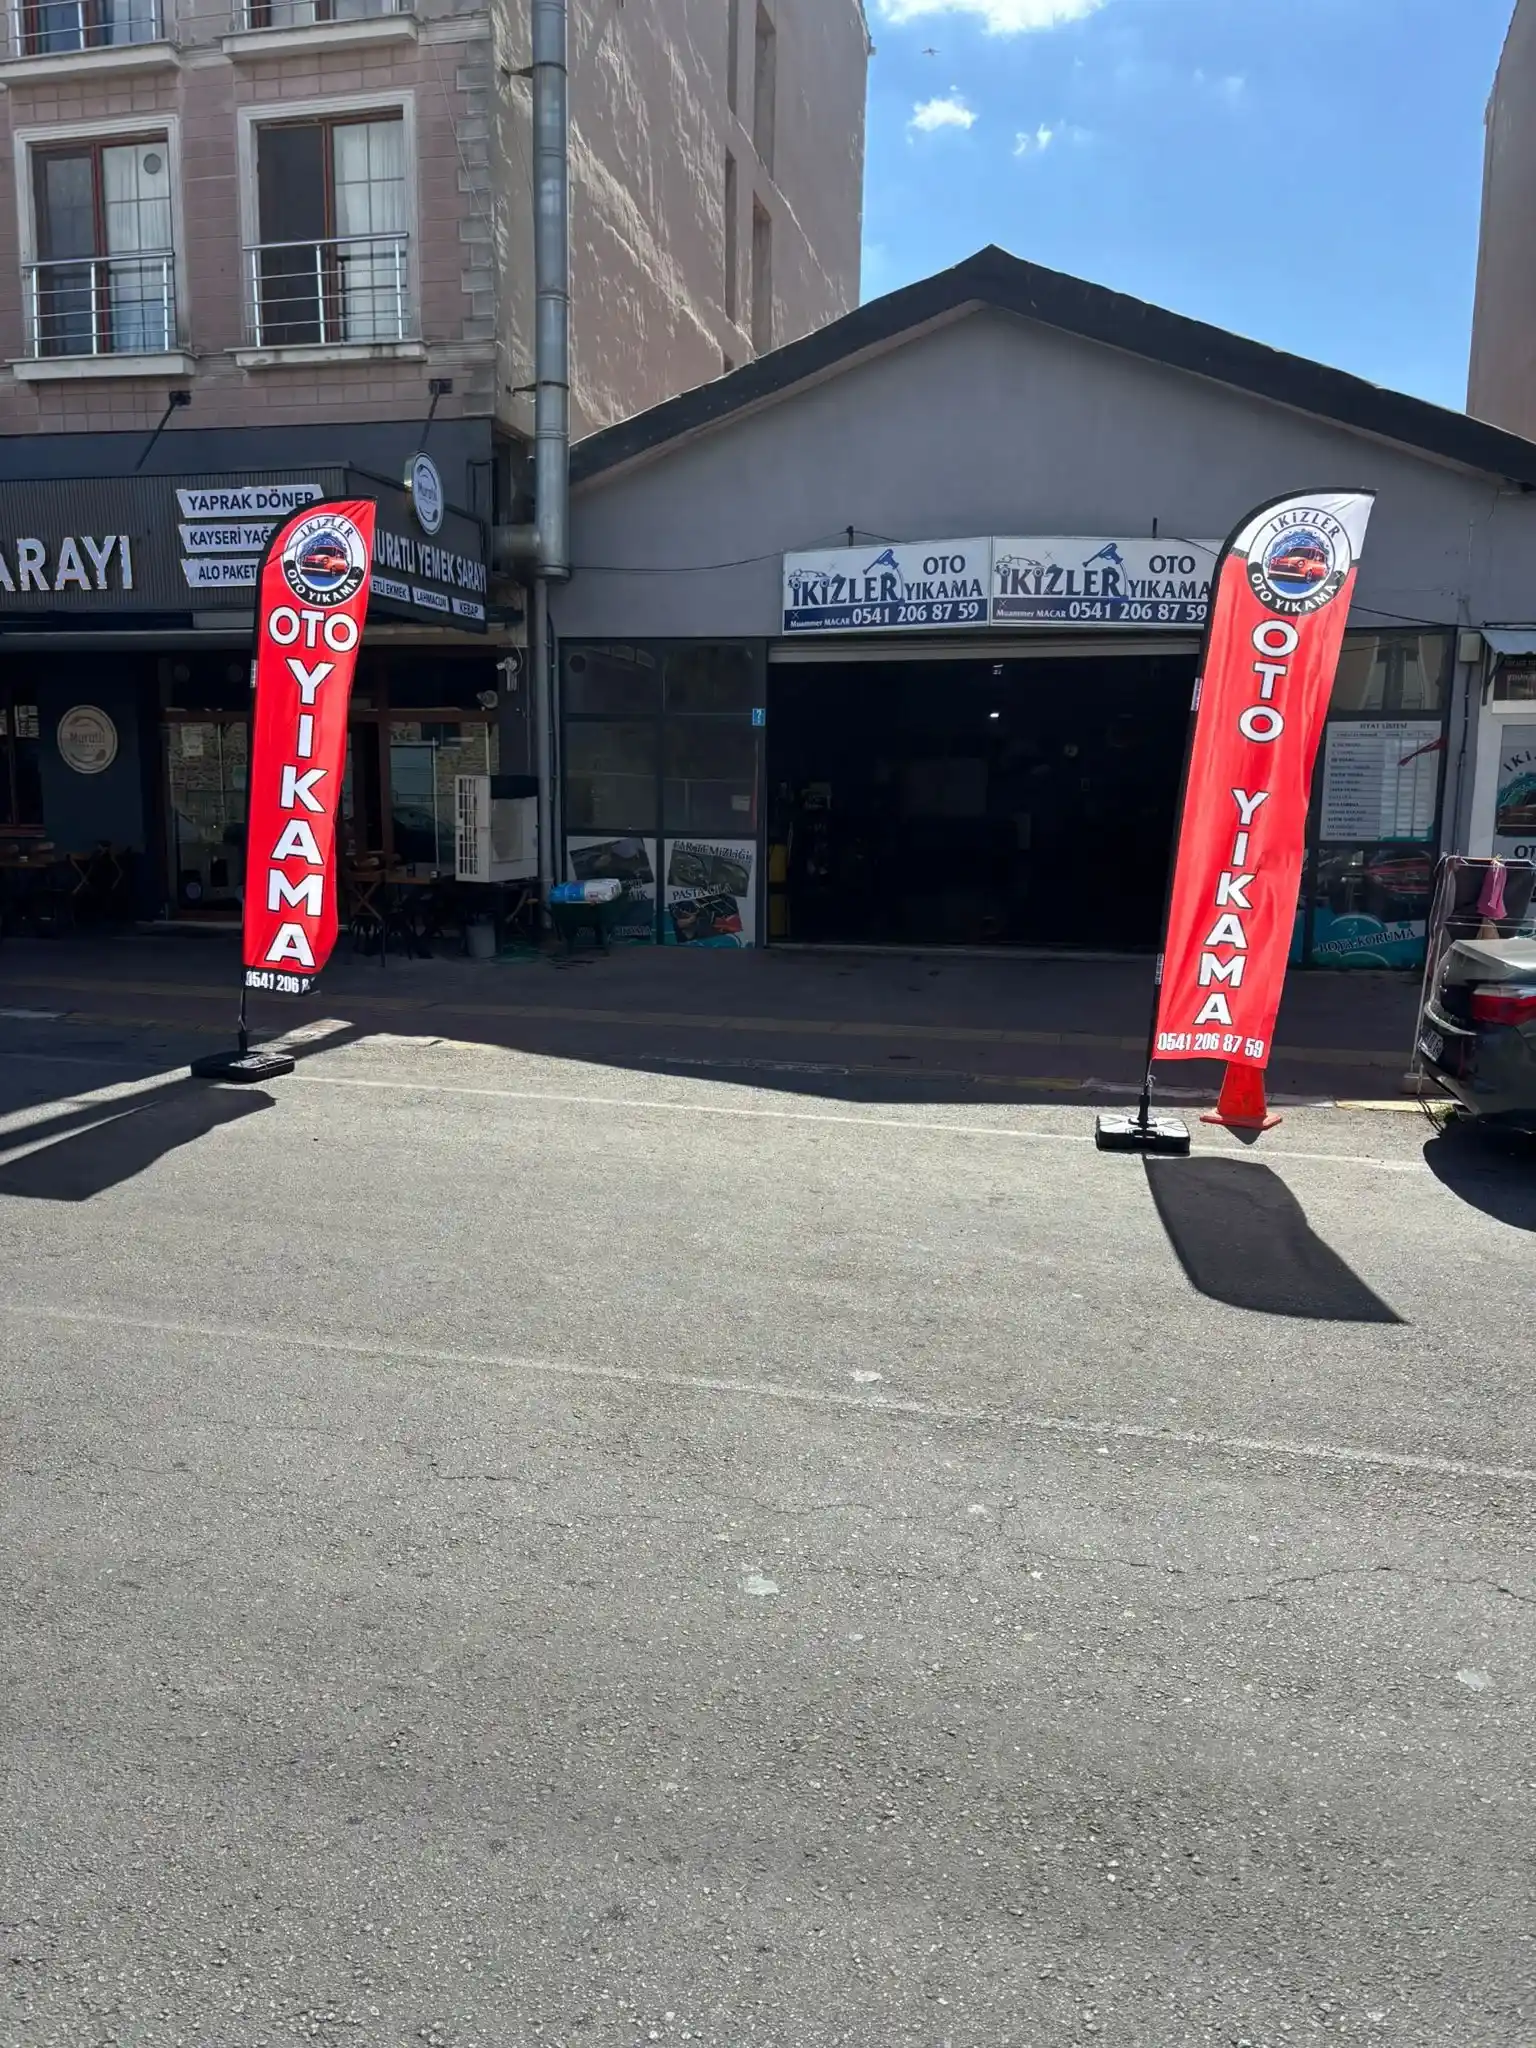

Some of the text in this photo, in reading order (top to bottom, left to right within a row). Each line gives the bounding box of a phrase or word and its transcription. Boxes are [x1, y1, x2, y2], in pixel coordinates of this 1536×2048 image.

[188, 494, 252, 511] YAPRAK
[190, 527, 241, 545] KAYSERİ
[199, 564, 257, 580] ALO PAKET
[417, 543, 455, 584] YEMEK
[456, 555, 487, 594] SARAYI
[923, 554, 966, 575] OTO
[1149, 555, 1196, 574] OTO
[287, 569, 358, 603] OTO YIKAMA
[904, 578, 984, 601] YIKAMA
[1129, 579, 1210, 600] YIKAMA
[1251, 572, 1338, 613] OTO YIKAMA
[852, 605, 890, 624] 0541
[897, 603, 927, 622] 206
[931, 604, 951, 620] 87
[958, 602, 979, 618] 59
[1069, 602, 1111, 618] 0541
[1119, 603, 1153, 619] 206
[1157, 603, 1181, 620] 87
[1186, 604, 1208, 620] 59
[268, 605, 359, 653] OTO
[1238, 618, 1300, 744] OTO
[264, 656, 336, 968] YIKAMA
[1193, 787, 1270, 1027] YIKAMA
[245, 970, 274, 990] 0541
[276, 974, 300, 993] 206
[1157, 1032, 1264, 1058] 0541 206 87 59
